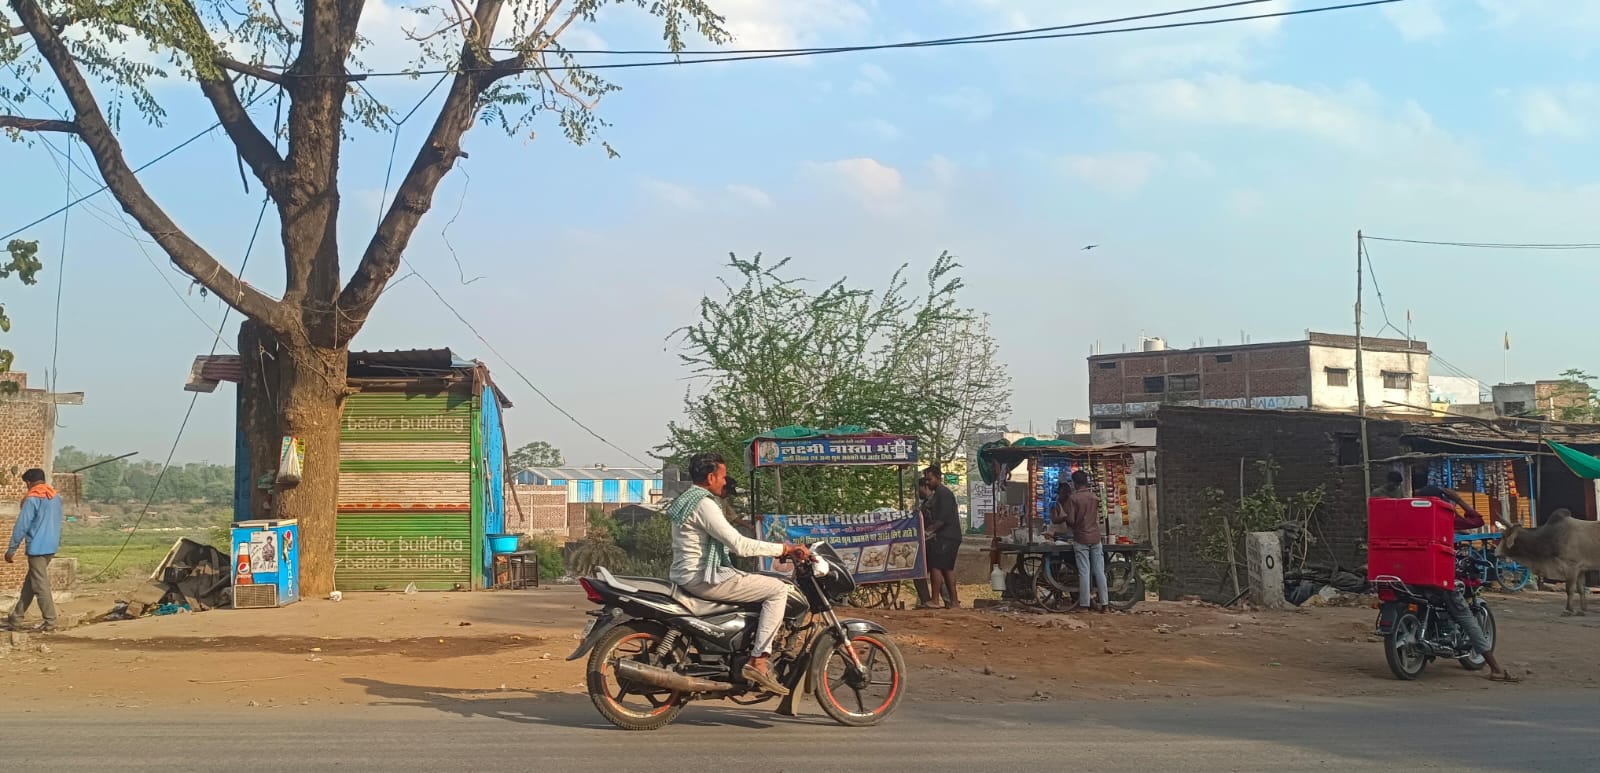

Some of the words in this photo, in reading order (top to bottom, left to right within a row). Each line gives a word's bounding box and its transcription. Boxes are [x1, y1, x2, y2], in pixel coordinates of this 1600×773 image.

[347, 415, 396, 431] better
[400, 415, 464, 433] building
[781, 443, 825, 455] लक्ष्मी
[829, 444, 872, 454] नास्ता
[345, 536, 394, 552] better
[345, 555, 394, 569] better
[398, 555, 463, 573] building
